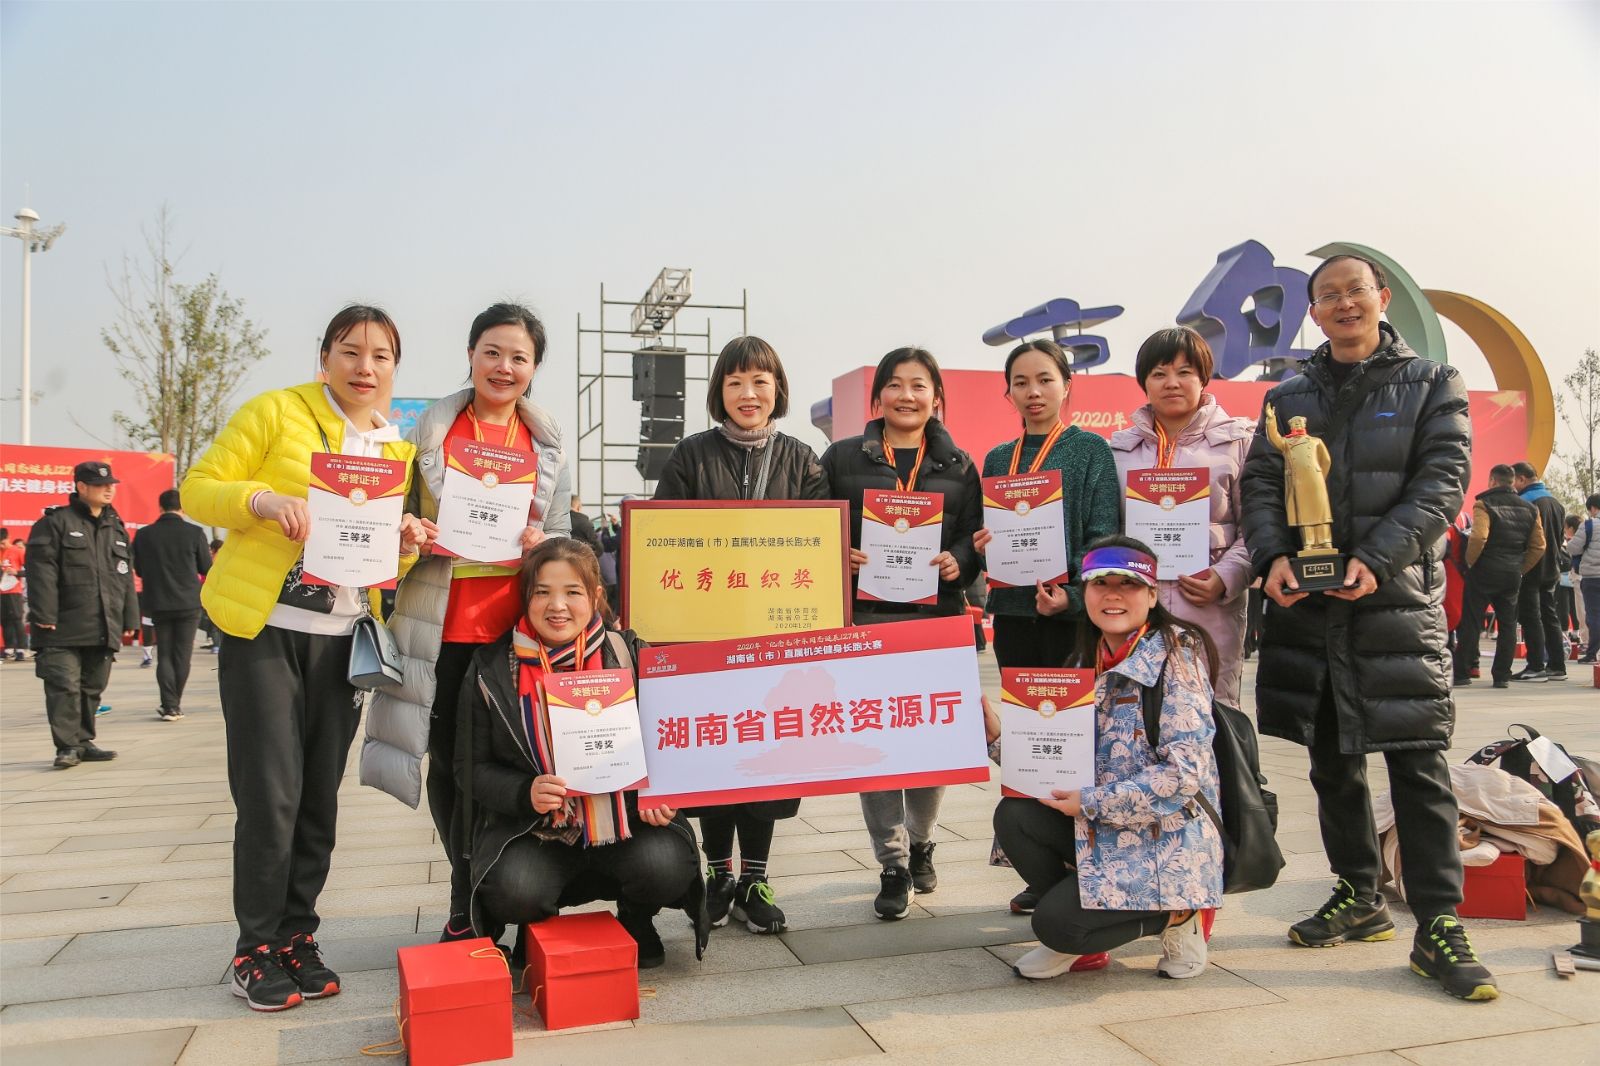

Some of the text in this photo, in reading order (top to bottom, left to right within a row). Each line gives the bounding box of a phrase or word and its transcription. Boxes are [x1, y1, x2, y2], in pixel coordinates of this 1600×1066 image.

[1071, 411, 1128, 431] 2020年
[473, 457, 512, 472] 荣誉证书
[338, 472, 380, 486] 荣誉证书
[0, 478, 77, 494] 机关健身长
[1149, 483, 1186, 493] 荣誉证书
[1004, 487, 1040, 500] 荣誉证书
[469, 510, 499, 522] 三等奖
[885, 505, 921, 516] 荣誉证书
[339, 531, 371, 543] 三等奖
[646, 537, 821, 548] 2020年湖南省（市）直属机关健身长跑大赛
[1012, 538, 1038, 548] 三等奖
[1153, 533, 1181, 542] 三等奖
[886, 555, 913, 565] 三等奖
[660, 567, 814, 592] 优秀组织奖
[726, 639, 883, 665] 湖南省（市）直属机关健身长跑大赛
[736, 642, 762, 651] 2020年
[571, 685, 611, 697] 荣誉证书
[1027, 686, 1068, 697] 荣誉证书
[656, 690, 962, 750] 湖南省自然资源厅
[584, 739, 614, 751] 三等奖
[1032, 744, 1062, 755] 三等奖
